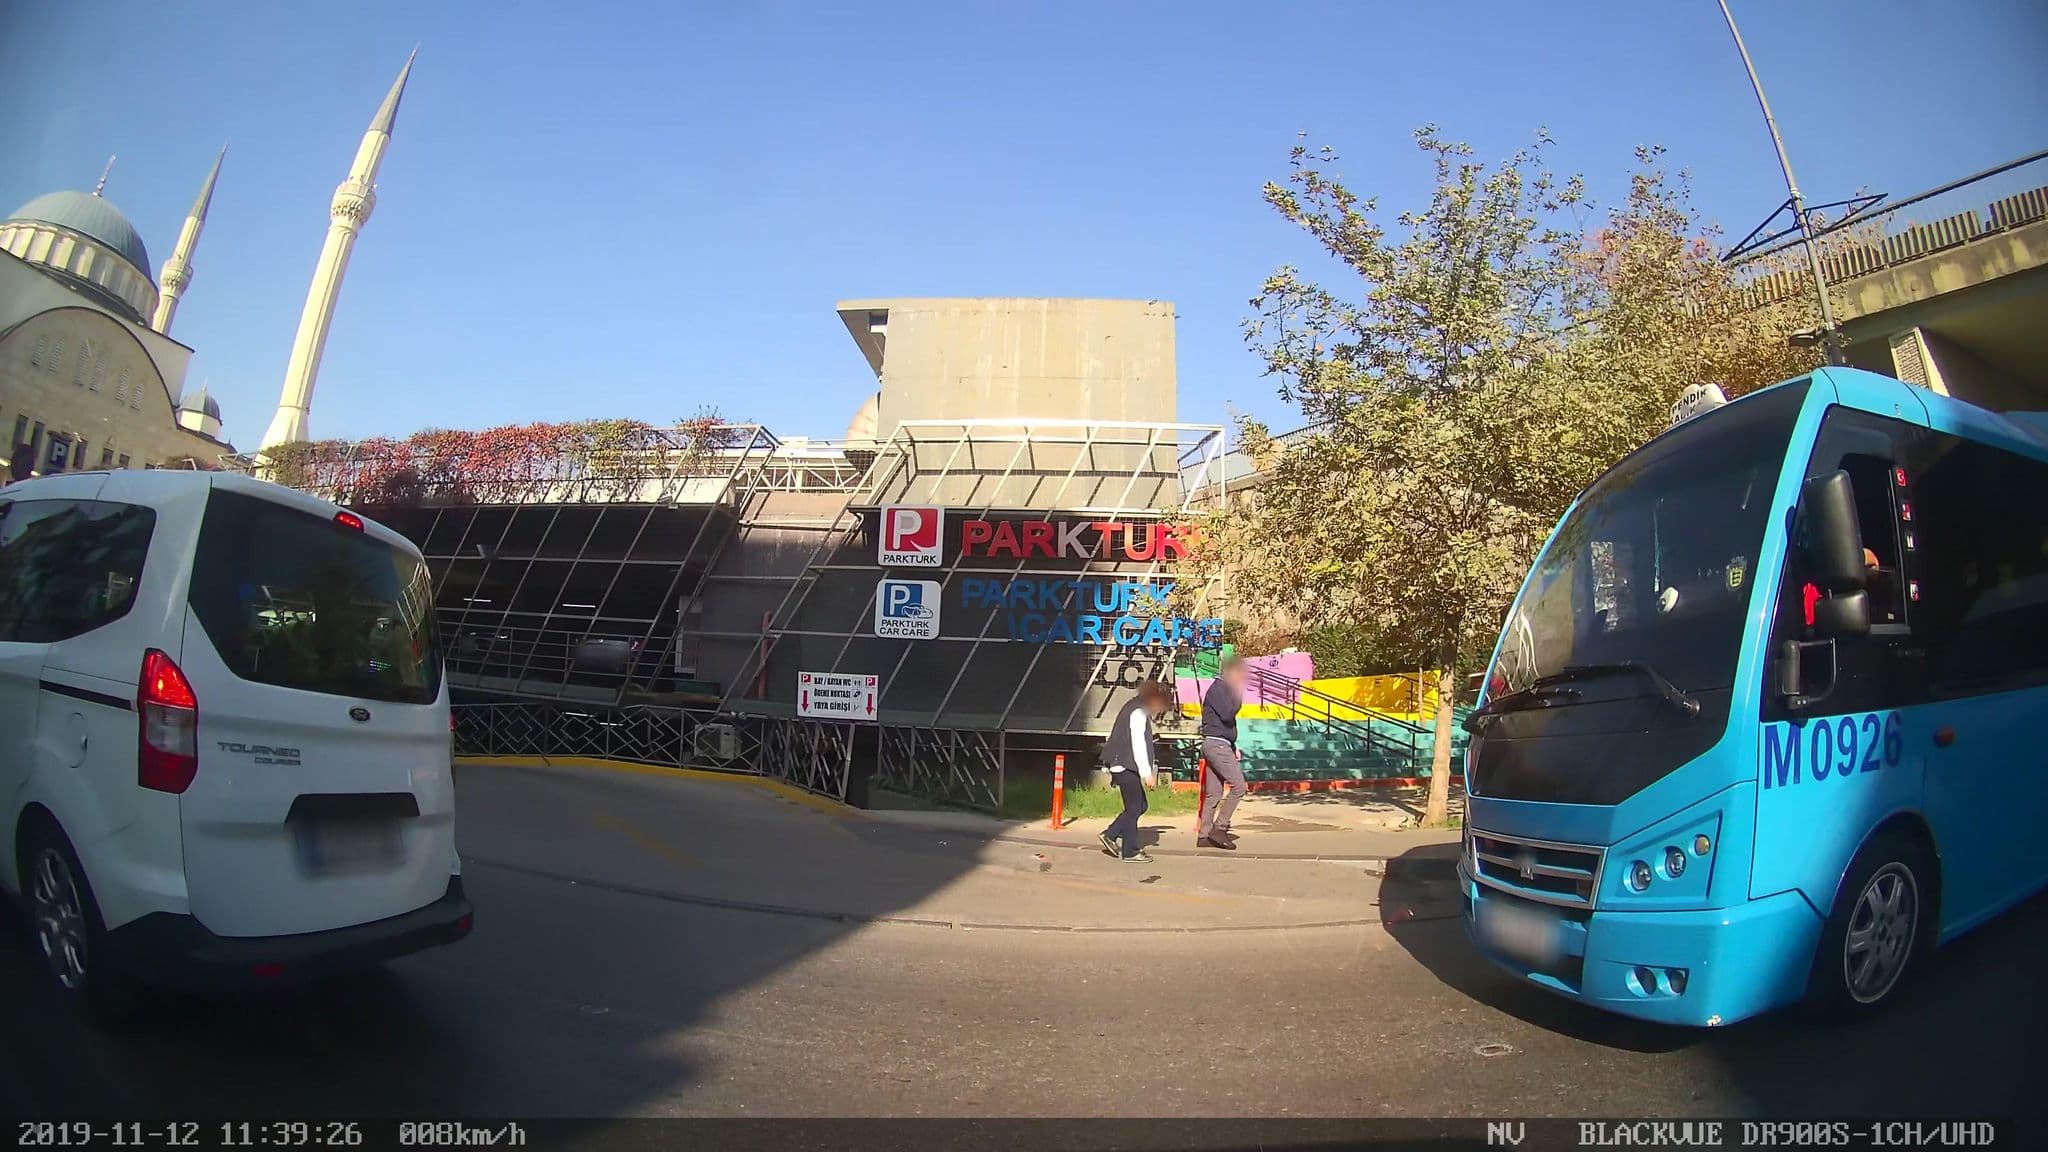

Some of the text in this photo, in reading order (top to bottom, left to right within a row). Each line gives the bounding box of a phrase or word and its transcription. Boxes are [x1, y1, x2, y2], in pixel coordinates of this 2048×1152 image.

[51, 440, 66, 461] P
[961, 520, 1206, 561] PARKTUR
[883, 554, 937, 564] PARKTURK
[881, 619, 929, 628] PARKTURK
[880, 627, 899, 635] CAR
[217, 741, 301, 757] TOURNEO
